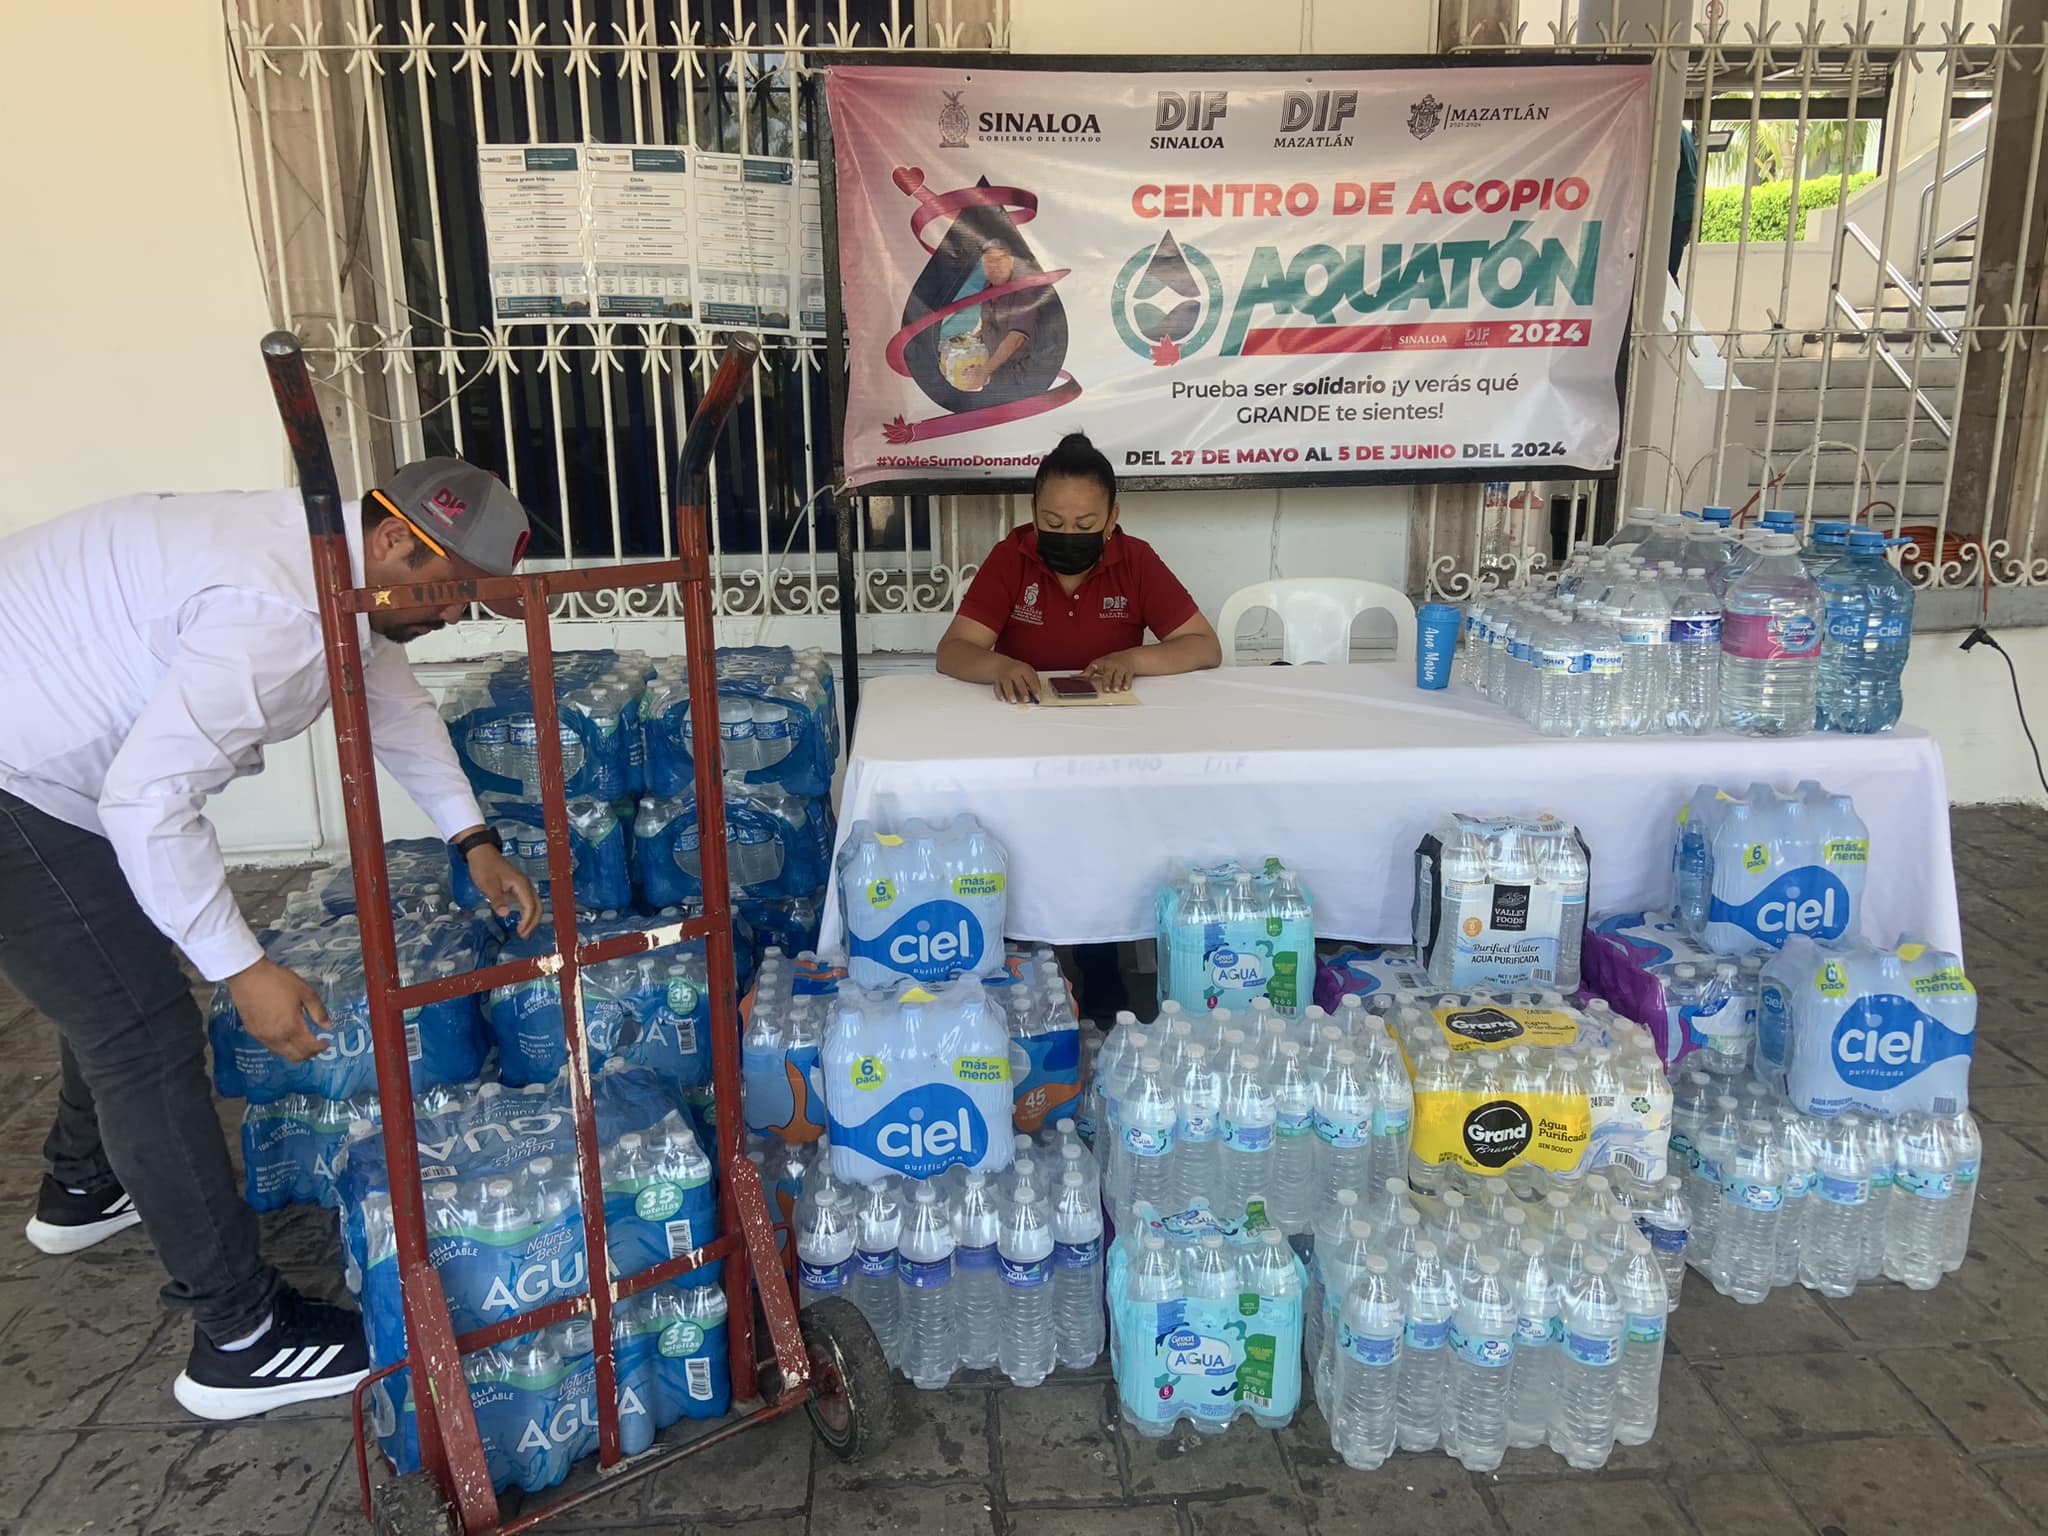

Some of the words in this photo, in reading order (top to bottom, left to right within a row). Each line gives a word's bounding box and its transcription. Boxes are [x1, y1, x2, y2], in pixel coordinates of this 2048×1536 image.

[1155, 91, 1228, 131] DIF
[1280, 90, 1358, 132] DIF
[1452, 103, 1549, 122] MAZATLÁN
[979, 112, 1101, 134] SINALOA
[1150, 136, 1225, 149] SINALOA
[1273, 134, 1354, 148] MAZATLÁN
[1132, 183, 1319, 218] CENTRO
[1333, 182, 1395, 216] DE
[1407, 177, 1590, 215] ACOPIO
[1219, 220, 1602, 356] AQUATÓN
[1399, 335, 1447, 346] SINALOA
[1508, 324, 1583, 343] 2024
[1172, 381, 1248, 399] Prueba
[1254, 382, 1287, 397] ser
[1293, 377, 1386, 396] solidario
[1415, 375, 1470, 393] verás
[1477, 374, 1518, 397] qué
[1237, 405, 1330, 424] GRANDE
[1336, 406, 1357, 422] te
[1362, 403, 1443, 421] sientes!
[1125, 450, 1165, 466] DEL
[1171, 450, 1194, 465] 27
[1202, 449, 1229, 464] DE
[1237, 448, 1299, 464] MAYO
[1305, 446, 1332, 462] AL
[1338, 445, 1350, 462] 5
[1356, 445, 1385, 461] DE
[1390, 443, 1455, 460] JUNIO
[1462, 443, 1504, 459] DEL
[1511, 441, 1566, 458] 2024
[1879, 619, 1903, 637] ciel
[1752, 845, 1762, 859] 6
[875, 882, 887, 895] 6
[959, 885, 997, 895] menos
[1495, 907, 1525, 917] VALLEY
[1756, 886, 1835, 933] ciel
[1496, 916, 1524, 925] FOODS
[890, 919, 970, 964] ciel
[1472, 943, 1510, 954] Purified
[1512, 943, 1540, 953] Water
[1472, 955, 1493, 963] AGUA
[1494, 955, 1540, 964] PURIFICADA
[1218, 968, 1258, 981] AGUA
[672, 988, 693, 1002] 35
[1915, 982, 1966, 994] menos
[1838, 1020, 1925, 1065] ciel
[860, 1059, 873, 1076] 6
[961, 1058, 987, 1070] más
[855, 1073, 881, 1086] pack
[959, 1069, 1002, 1080] menos
[1849, 1069, 1904, 1077] purificada
[1025, 1088, 1047, 1108] 45
[877, 1107, 972, 1158] ciel
[1539, 1118, 1567, 1131] Agua
[1467, 1123, 1527, 1143] Grand
[1538, 1142, 1550, 1150] SIN
[1551, 1143, 1573, 1154] SODIO
[643, 1185, 676, 1209] 35
[639, 1203, 680, 1218] botellas
[524, 1227, 575, 1258] Nature's
[536, 1243, 562, 1262] Best
[664, 1326, 697, 1346] 35
[1171, 1334, 1195, 1344] Great
[1175, 1352, 1225, 1367] AGUA
